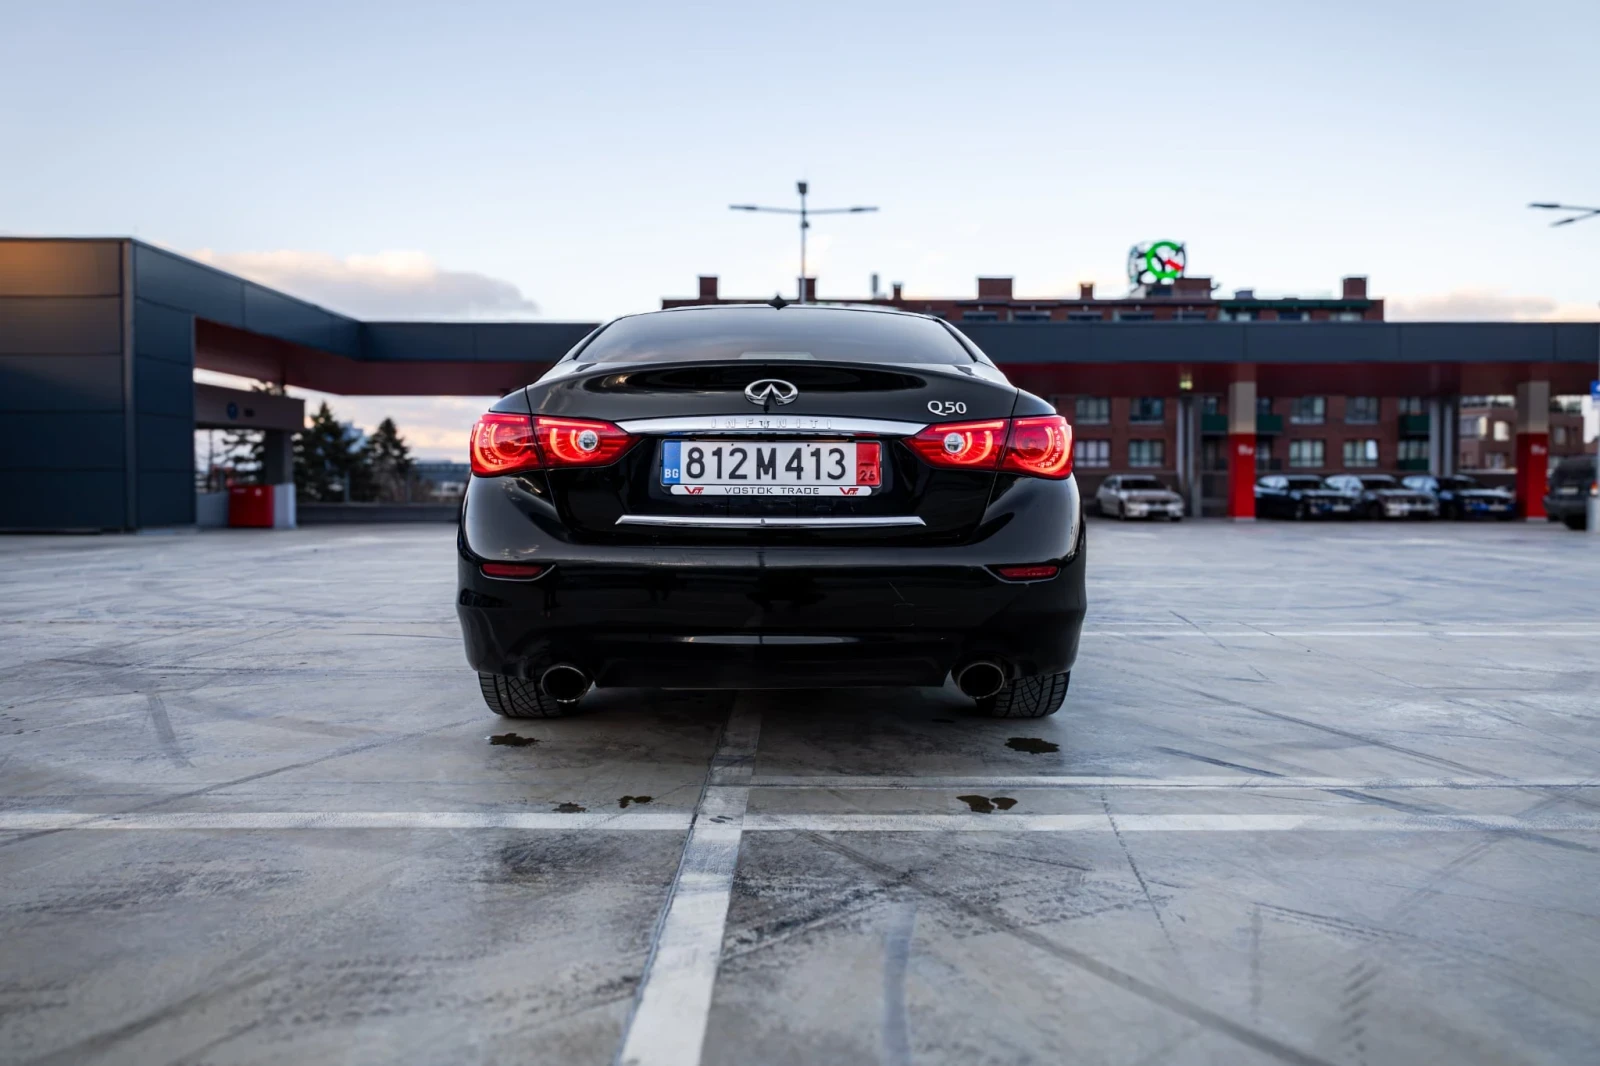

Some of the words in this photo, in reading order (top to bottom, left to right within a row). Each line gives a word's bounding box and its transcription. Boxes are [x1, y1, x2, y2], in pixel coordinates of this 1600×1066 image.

[927, 400, 967, 416] Q50
[710, 418, 832, 430] INFINITI
[664, 468, 679, 479] BG
[724, 486, 774, 495] VOSTOK
[780, 487, 820, 495] TRADE
